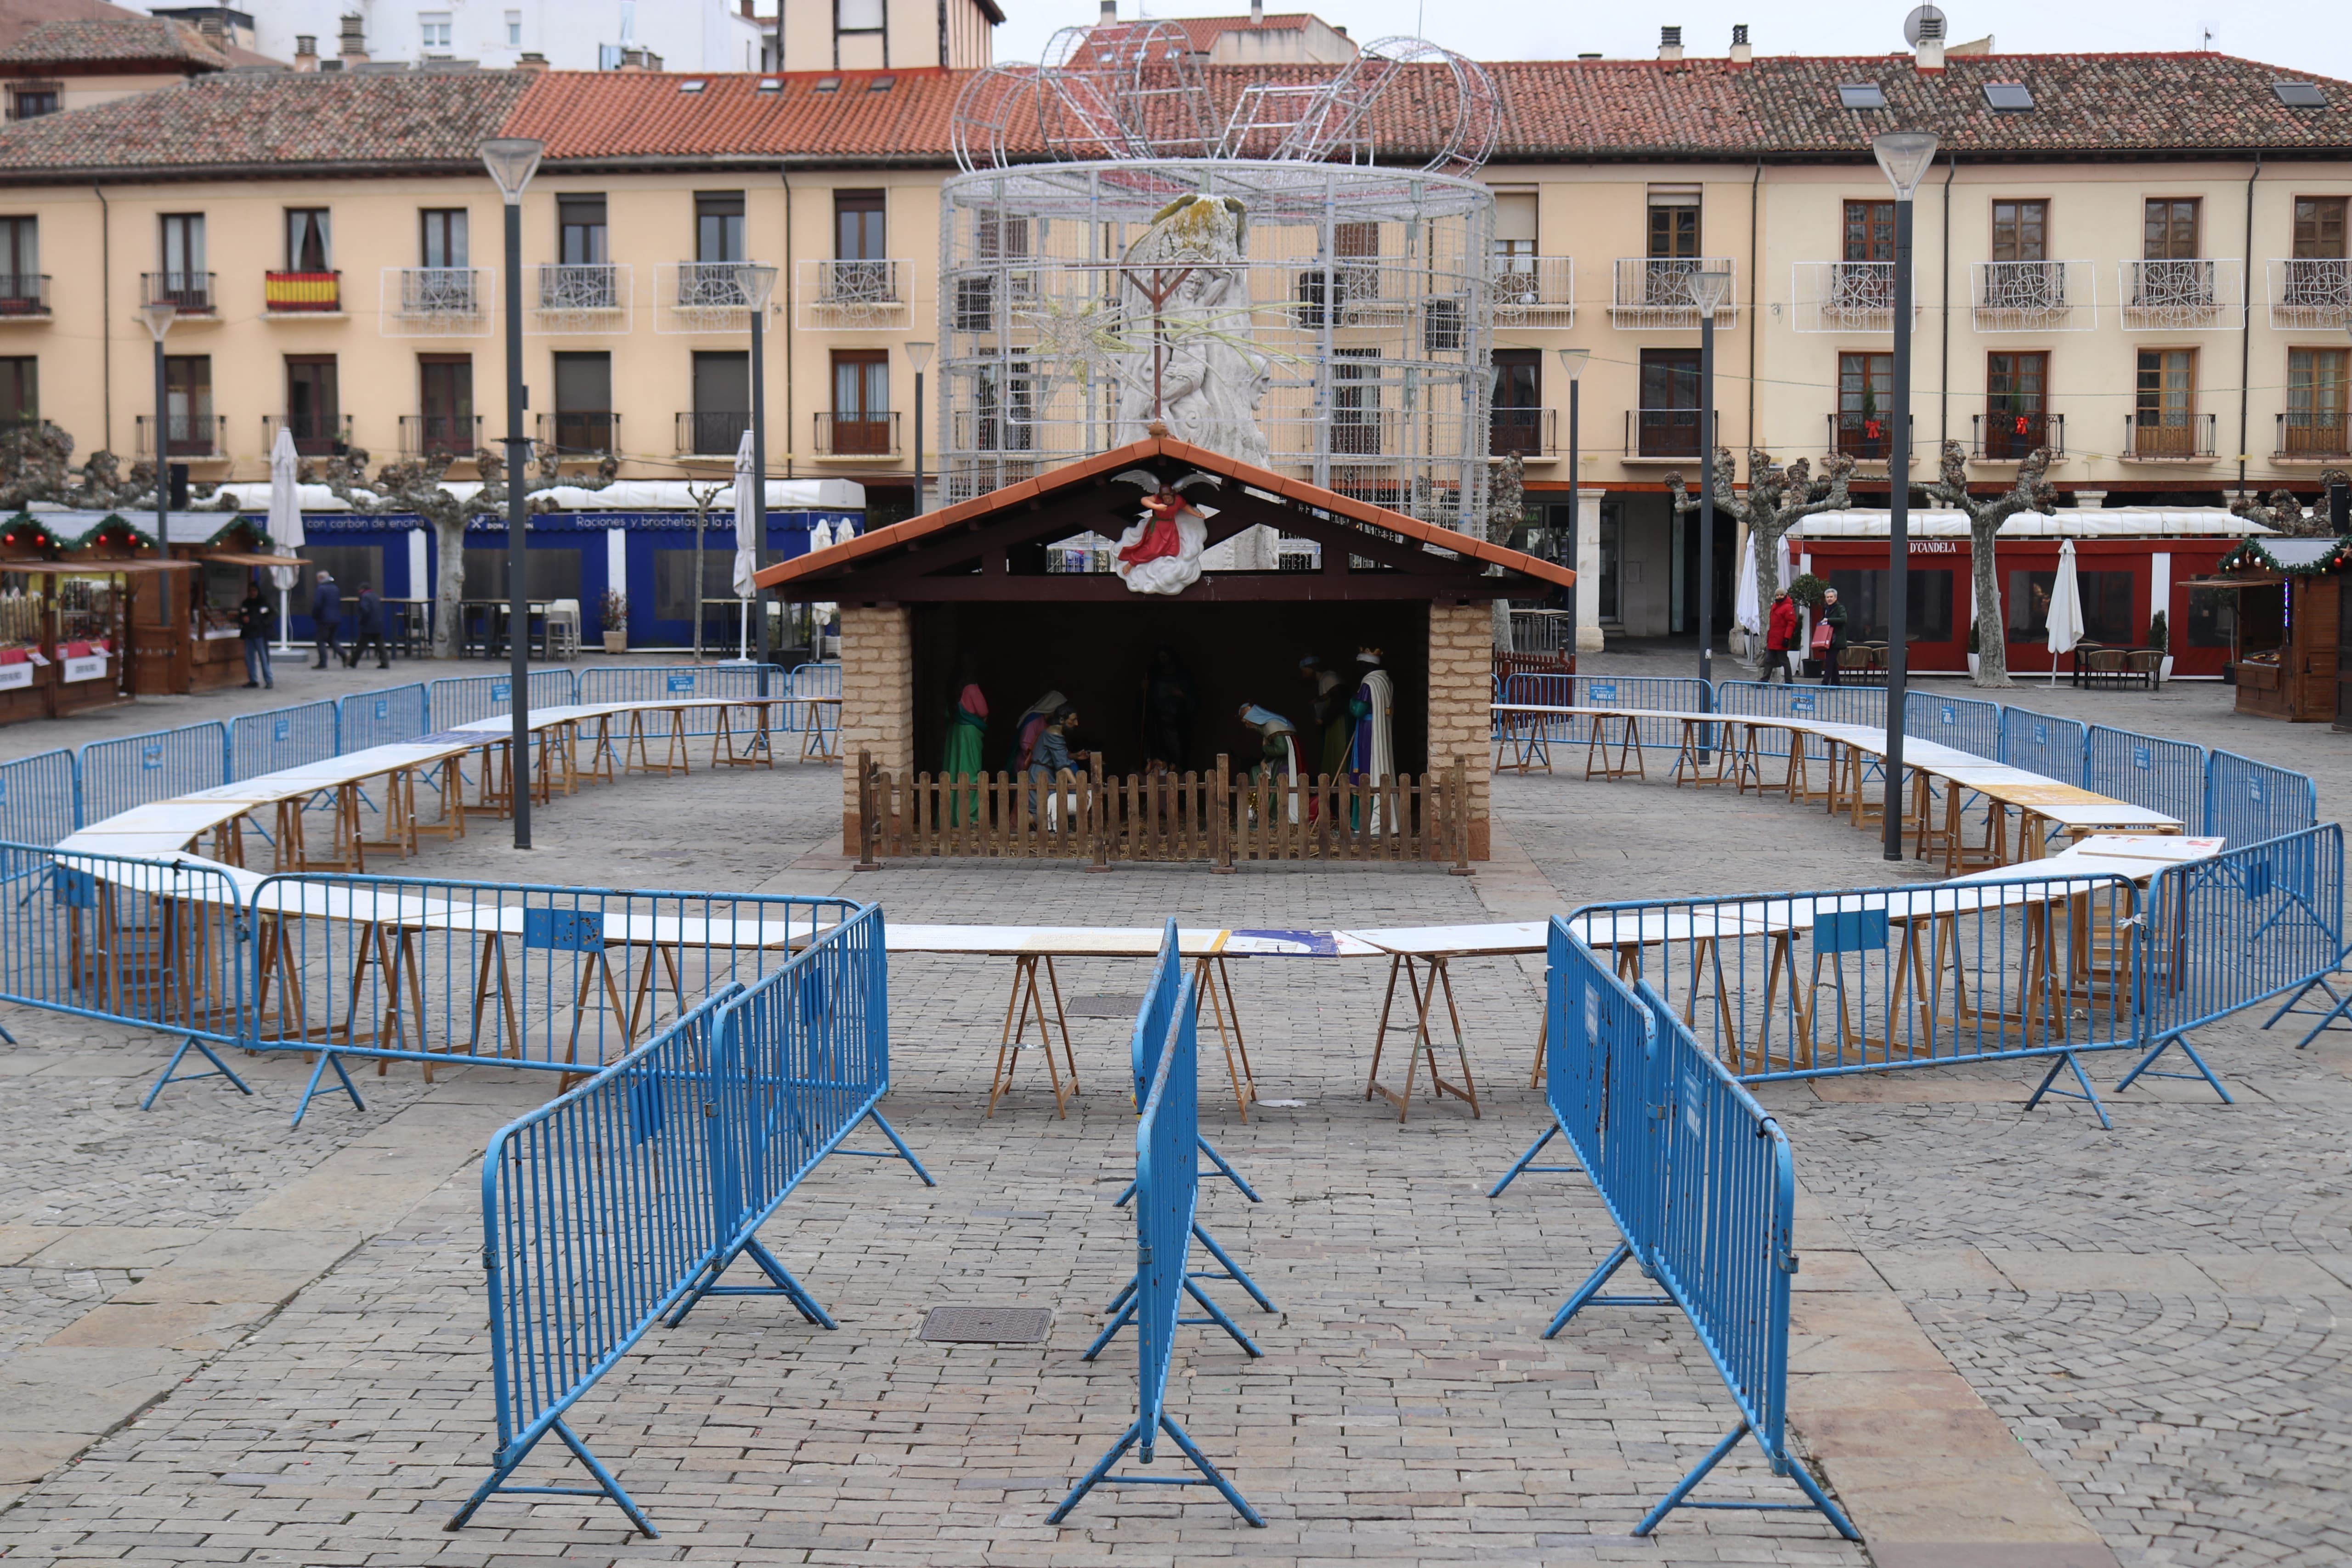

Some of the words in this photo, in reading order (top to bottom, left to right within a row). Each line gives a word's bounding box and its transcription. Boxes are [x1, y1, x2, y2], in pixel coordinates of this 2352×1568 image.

[306, 520, 327, 529] con
[330, 516, 368, 529] carbón
[372, 517, 385, 528] de
[389, 517, 425, 528] encina
[576, 516, 626, 527] Raciones
[630, 519, 638, 528] y
[641, 515, 697, 527] brochetas
[712, 515, 722, 527] la
[1910, 542, 1956, 553] D'CANDELA
